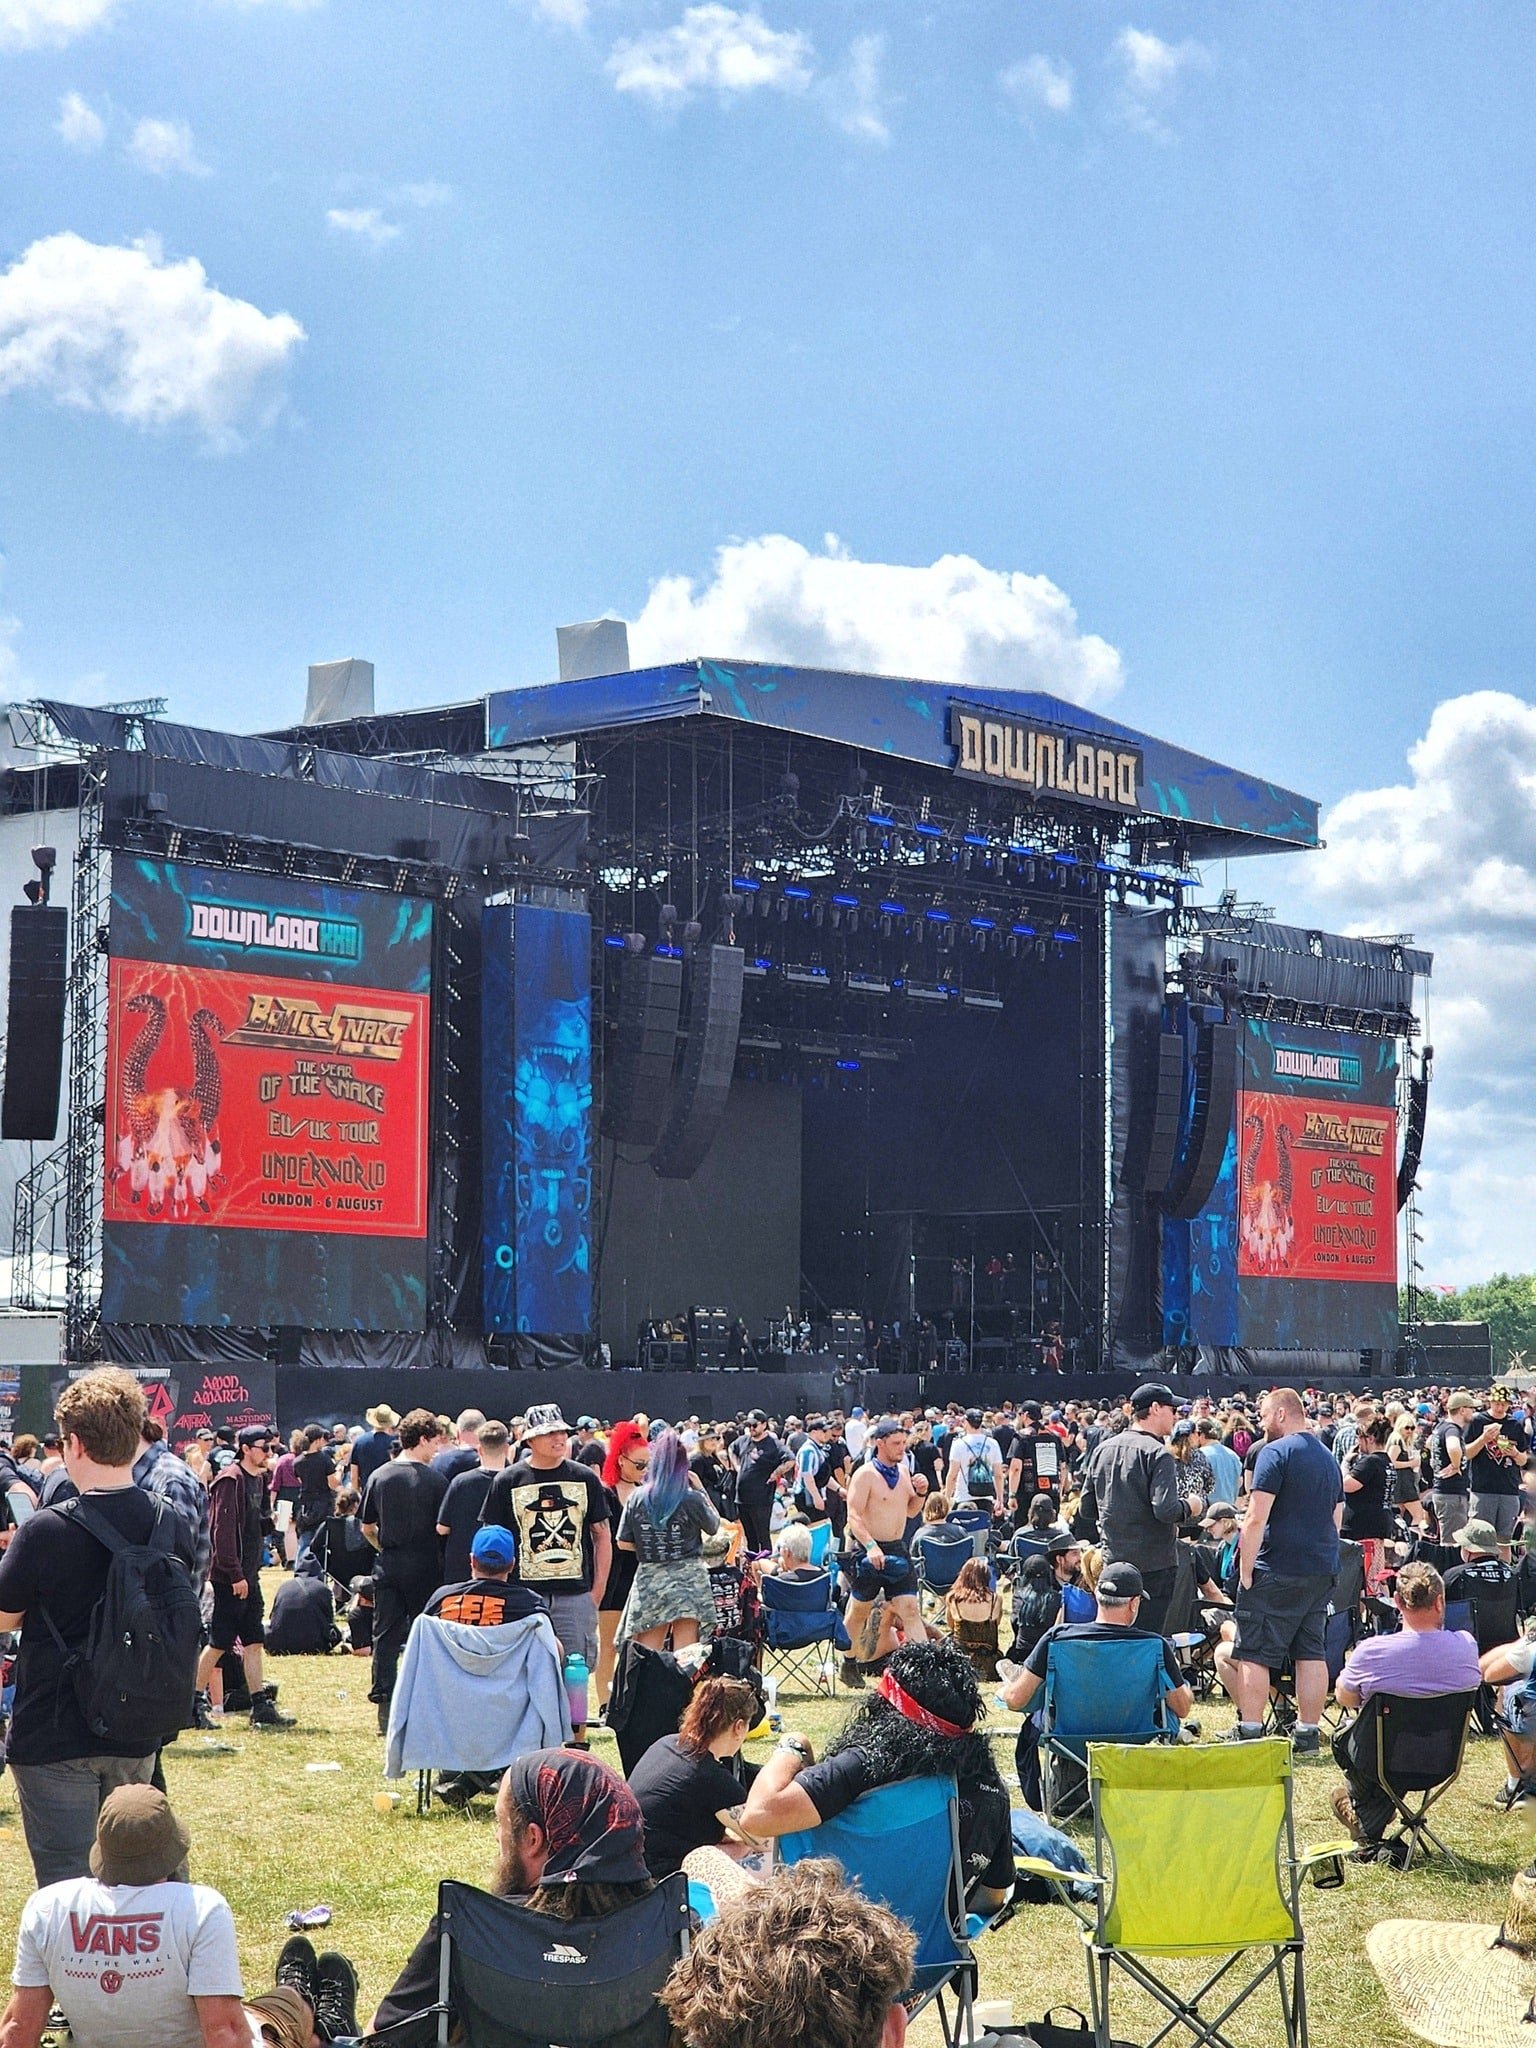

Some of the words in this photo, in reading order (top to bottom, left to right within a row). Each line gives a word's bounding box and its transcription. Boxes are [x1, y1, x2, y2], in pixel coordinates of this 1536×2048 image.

[959, 715, 1138, 807] DOWNLOAD
[191, 904, 320, 952] DOWNLOAD
[230, 994, 414, 1058] BATTLESNAKE
[296, 1060, 316, 1075] THE
[321, 1062, 353, 1078] YEAR
[1275, 1049, 1340, 1080] DOWNLOAD
[260, 1075, 282, 1103] OF
[289, 1074, 321, 1095] THE
[325, 1076, 385, 1113] SNAKE
[336, 1120, 380, 1144] TOUR
[261, 1151, 386, 1191] UNDERWORLD
[1312, 1169, 1323, 1188] OF
[1326, 1168, 1342, 1182] THE
[1344, 1169, 1375, 1194] SNAKE
[261, 1192, 312, 1207] LONDON
[325, 1196, 332, 1208] 6
[336, 1197, 383, 1211] AUGUST
[1351, 1199, 1373, 1217] TOUR
[1313, 1223, 1377, 1250] UNDERWORLD
[1313, 1253, 1340, 1263] LONDON
[1351, 1255, 1376, 1264] AUGUST
[202, 1375, 239, 1391] AMON
[193, 1386, 249, 1406] AMARTH
[173, 1411, 214, 1431] ANTHRAX
[225, 1414, 272, 1424] MASTODON
[69, 1910, 165, 1957] VANS
[94, 1960, 120, 1968] THE
[133, 1954, 172, 1966] WALL
[542, 1952, 587, 1965] TRESPASS
